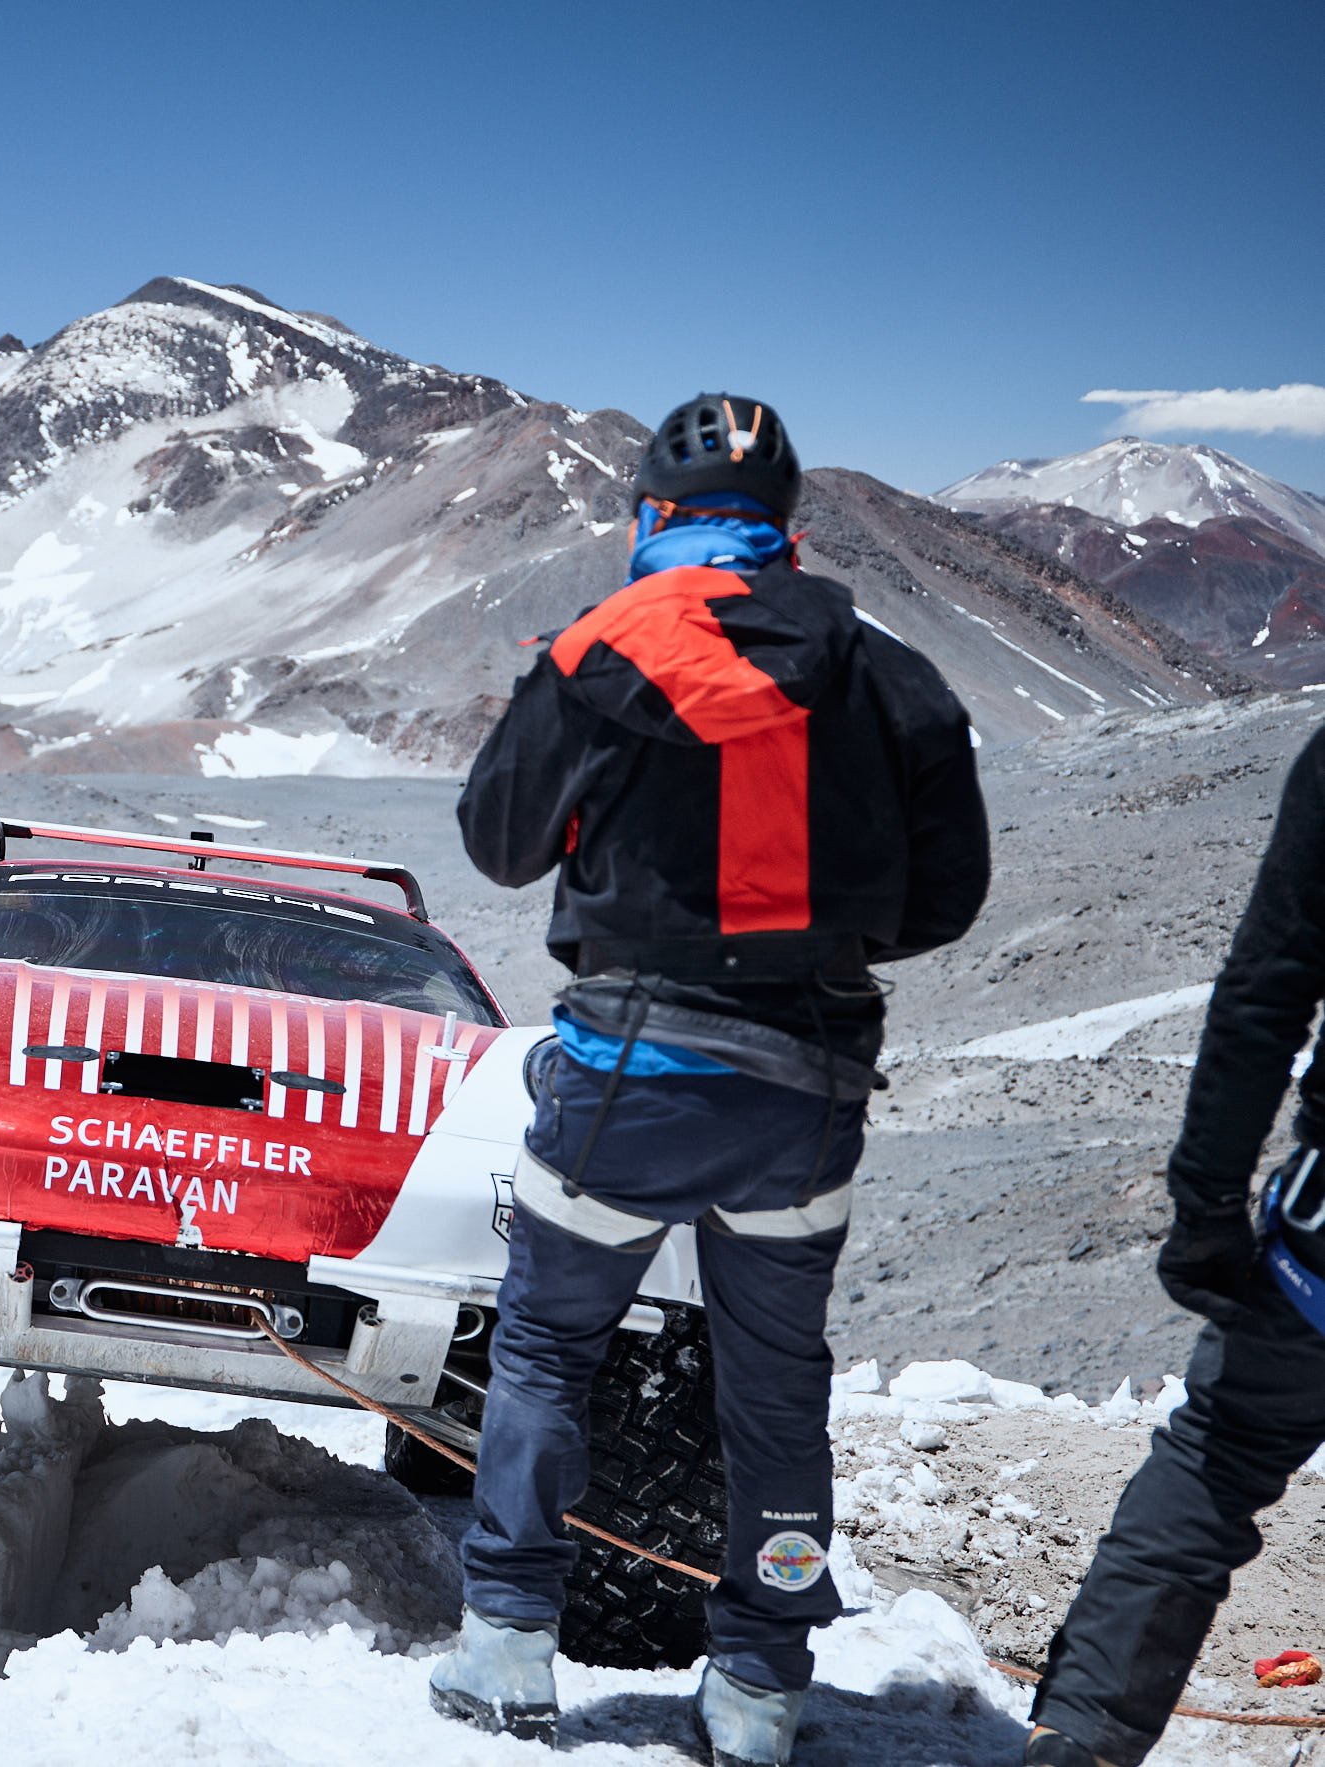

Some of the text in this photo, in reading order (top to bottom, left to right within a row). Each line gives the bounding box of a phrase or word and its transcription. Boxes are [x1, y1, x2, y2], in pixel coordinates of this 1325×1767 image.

[8, 873, 375, 925] PORSCHE
[48, 1115, 313, 1177] SCHAEFFLER
[44, 1155, 239, 1215] PARAVAN
[761, 1510, 819, 1521] MAMMUT
